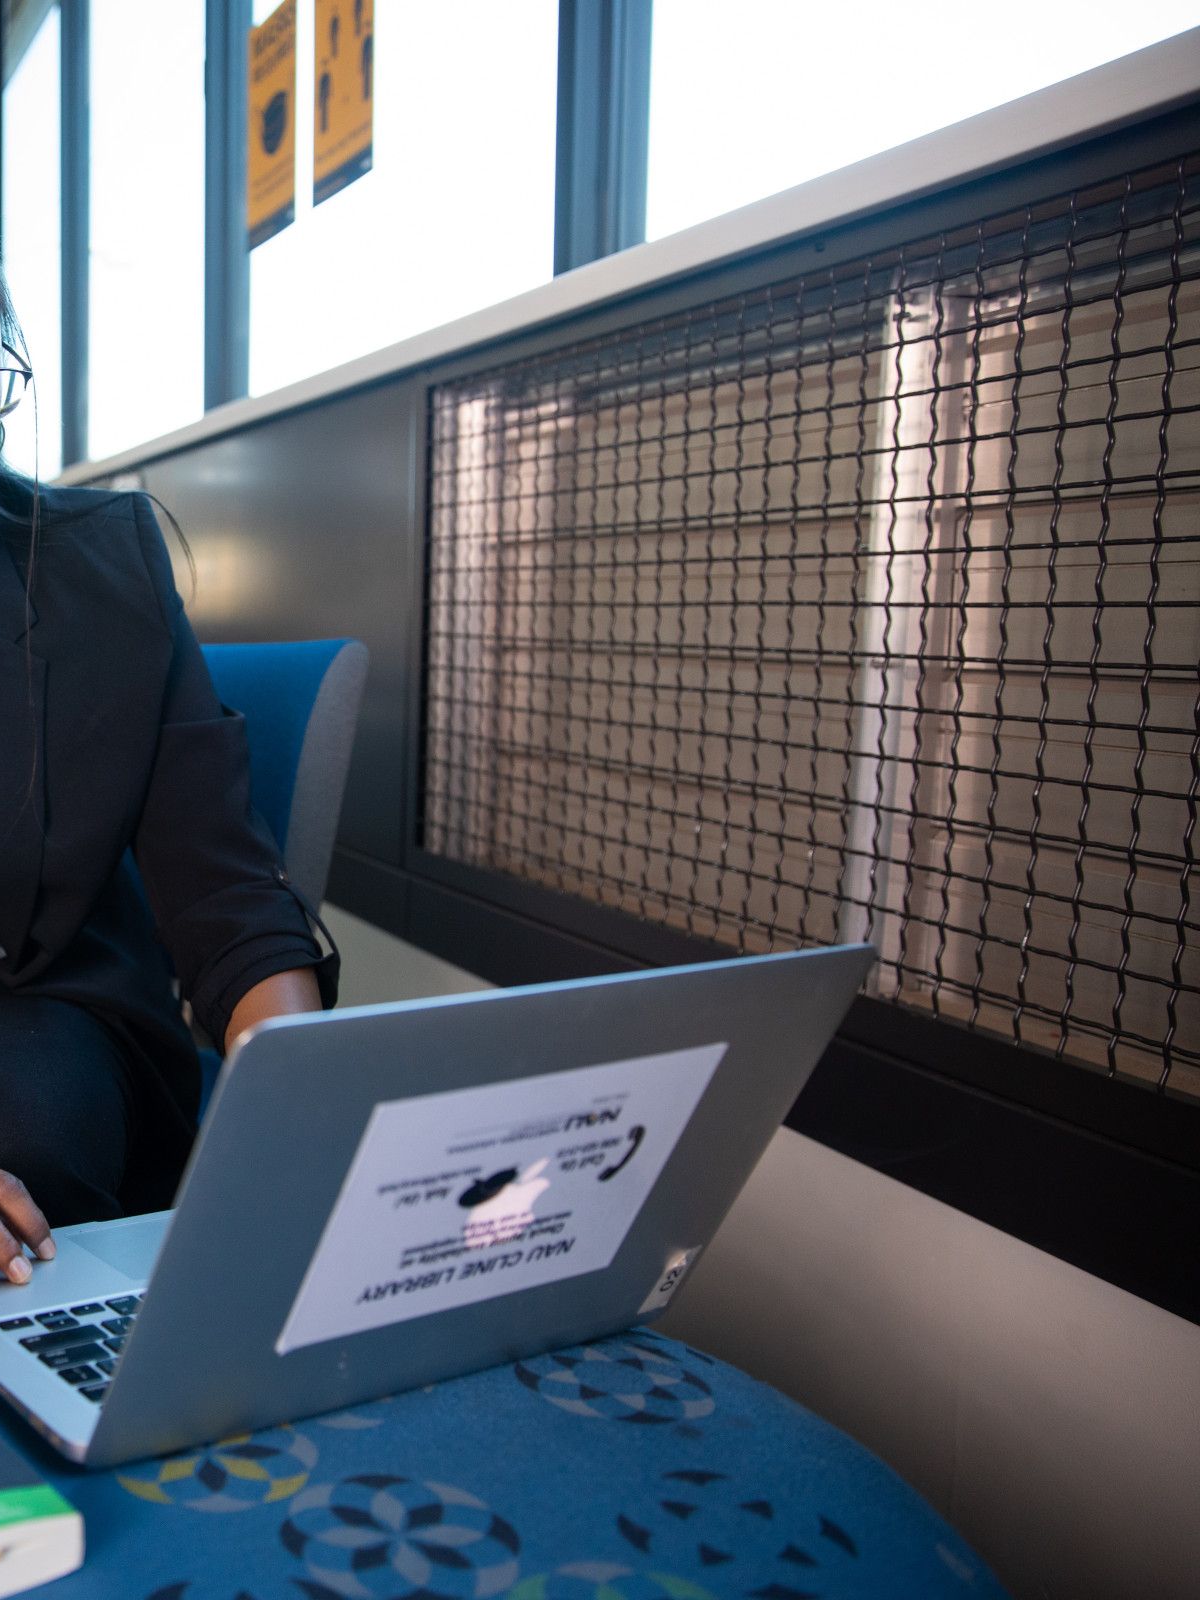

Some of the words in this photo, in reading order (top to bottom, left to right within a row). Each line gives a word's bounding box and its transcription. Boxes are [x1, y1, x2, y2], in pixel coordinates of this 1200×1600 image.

[563, 1107, 622, 1131] NAU
[526, 1238, 576, 1264] NAU
[458, 1250, 523, 1281] CLINE
[356, 1266, 455, 1305] LIBRARY
